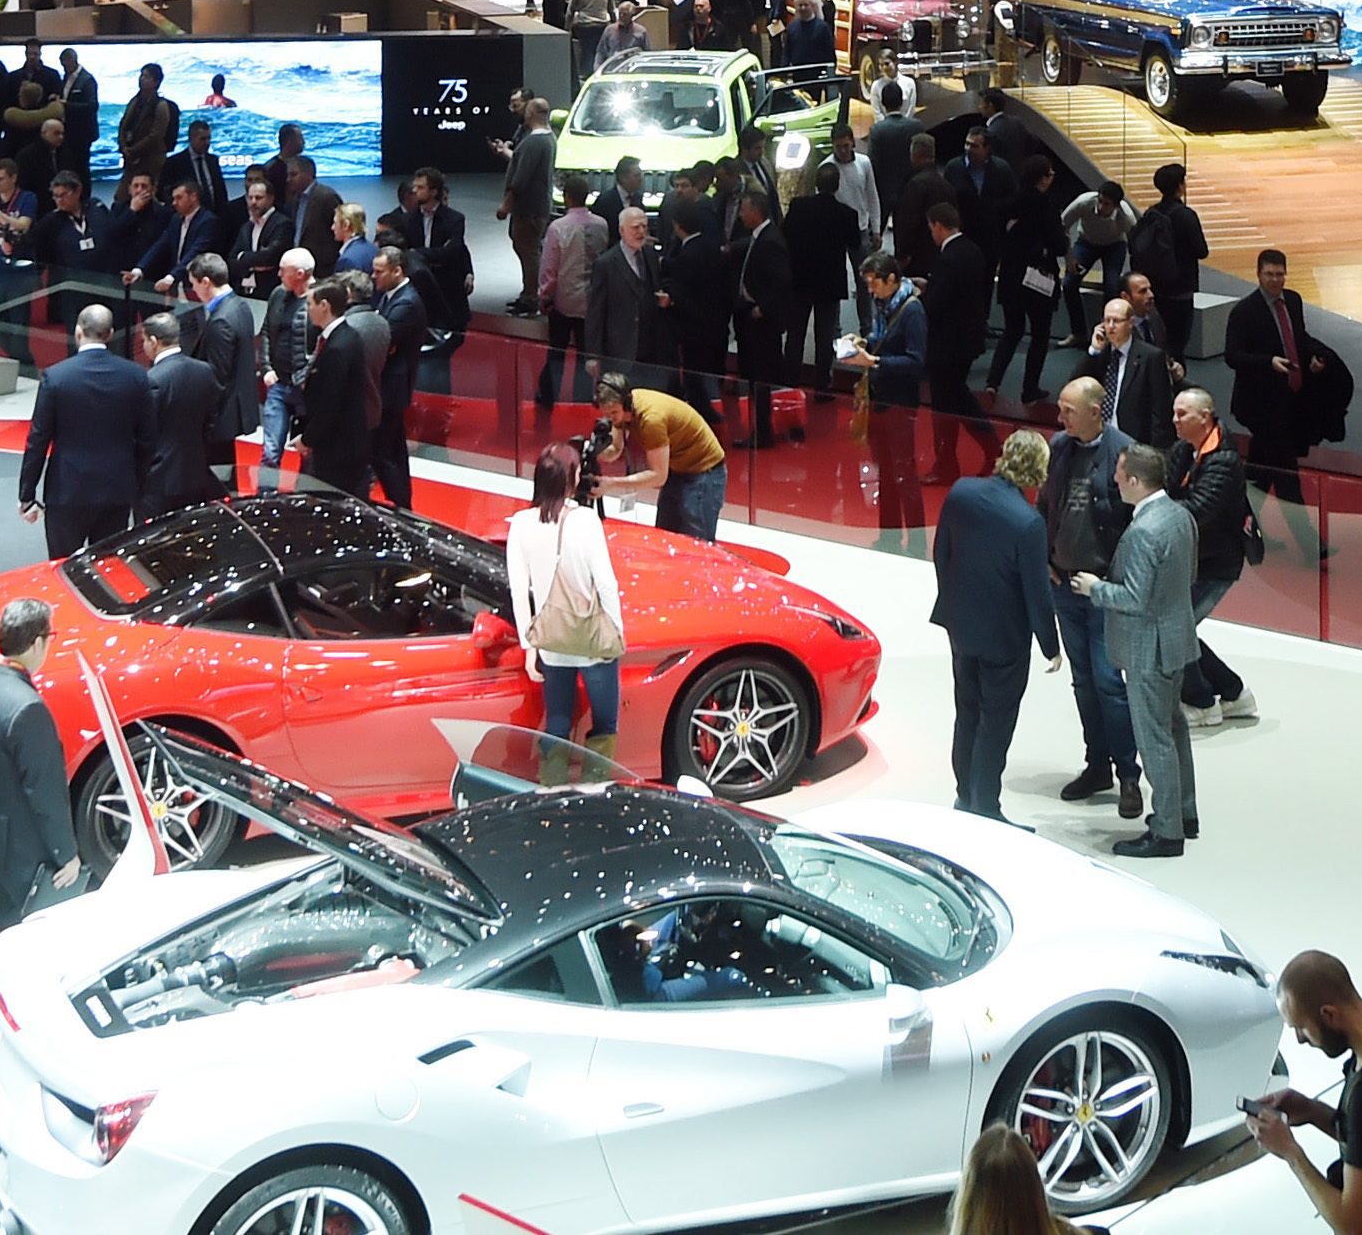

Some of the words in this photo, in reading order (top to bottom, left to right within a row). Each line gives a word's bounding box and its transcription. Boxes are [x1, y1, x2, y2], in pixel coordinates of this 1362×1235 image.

[438, 79, 468, 104] 75
[412, 107, 462, 115] YEARS
[438, 120, 466, 131] Jeep
